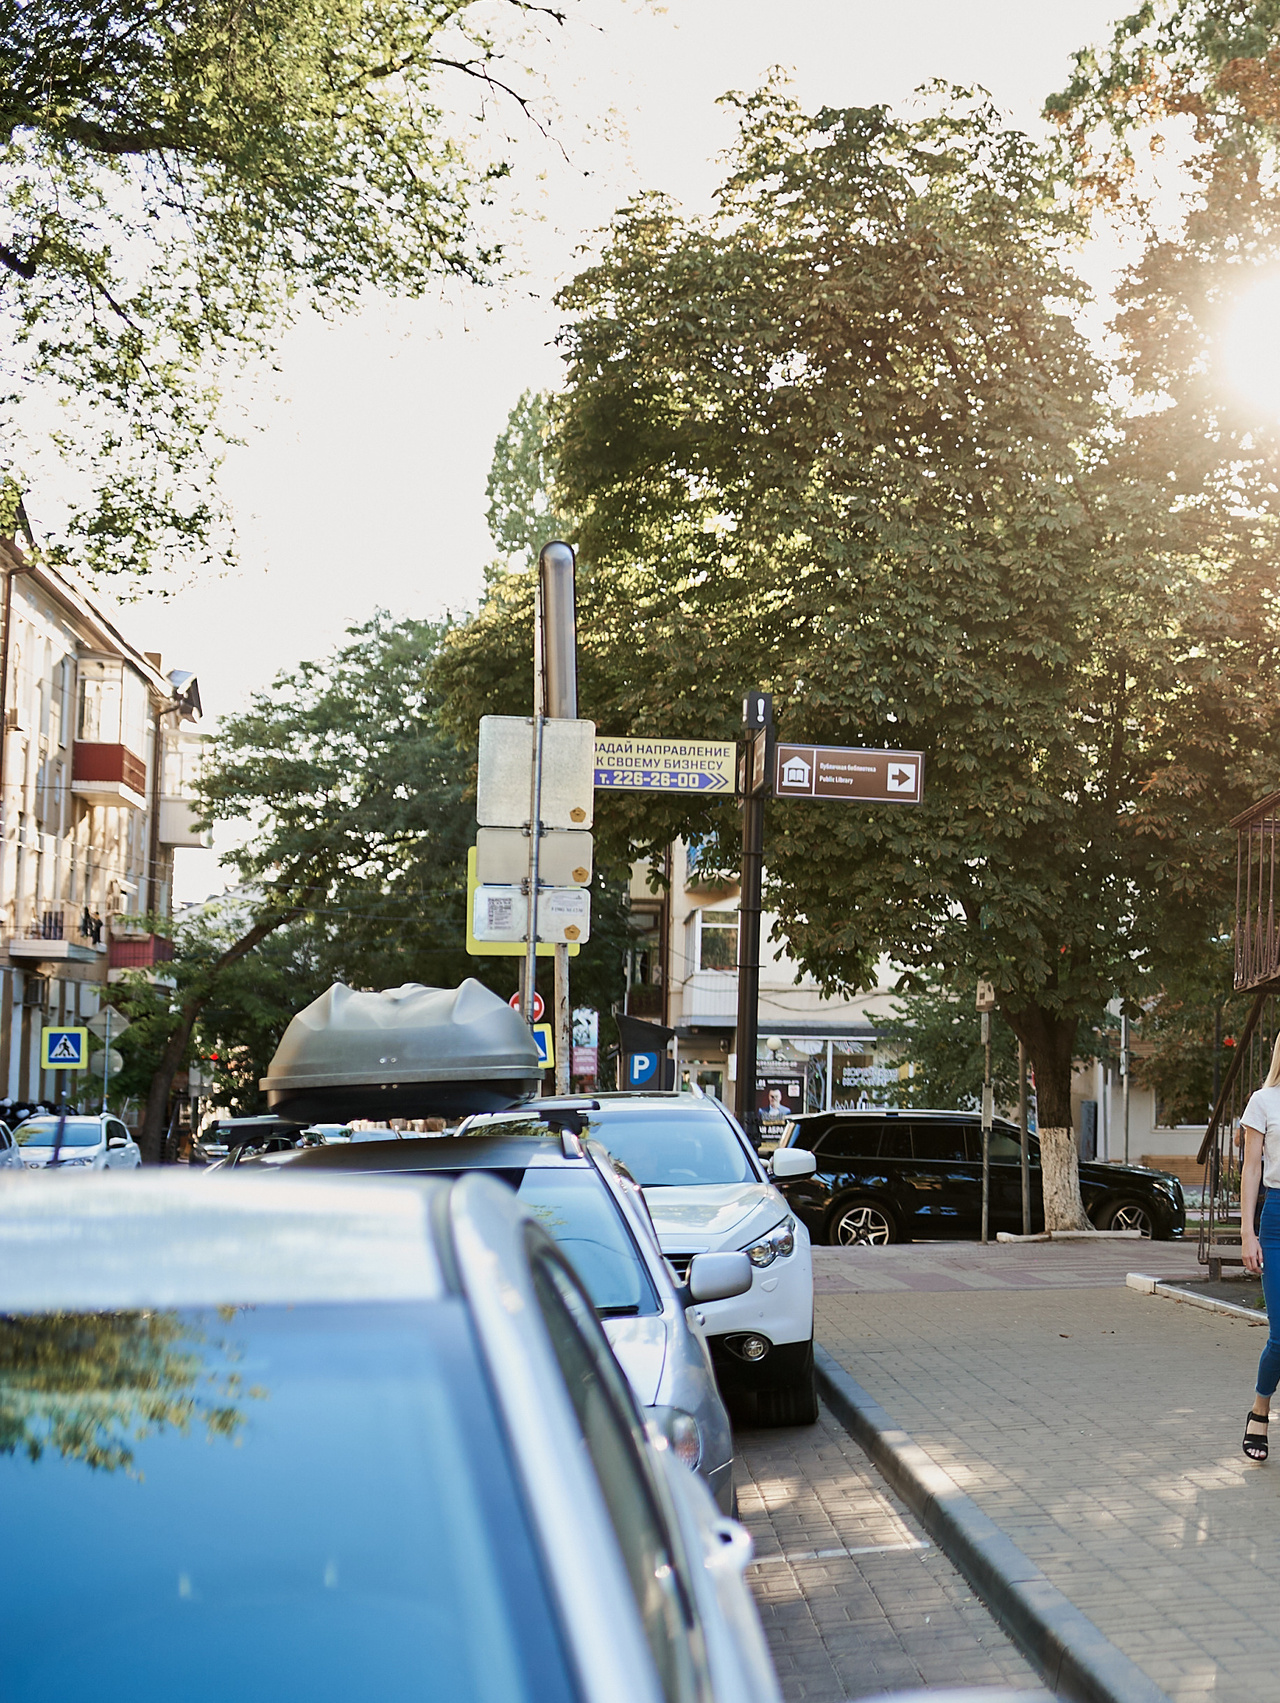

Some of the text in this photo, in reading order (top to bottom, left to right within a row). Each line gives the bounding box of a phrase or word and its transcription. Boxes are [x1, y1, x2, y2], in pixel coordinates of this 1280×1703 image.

[636, 744, 730, 757] НАПРАВЛЕНИЕ
[596, 756, 723, 770] К СВОЕМУ БИЗНЕСУ
[613, 771, 700, 788] 226-26-00
[819, 775, 854, 786] Public Library
[633, 1055, 650, 1079] P
